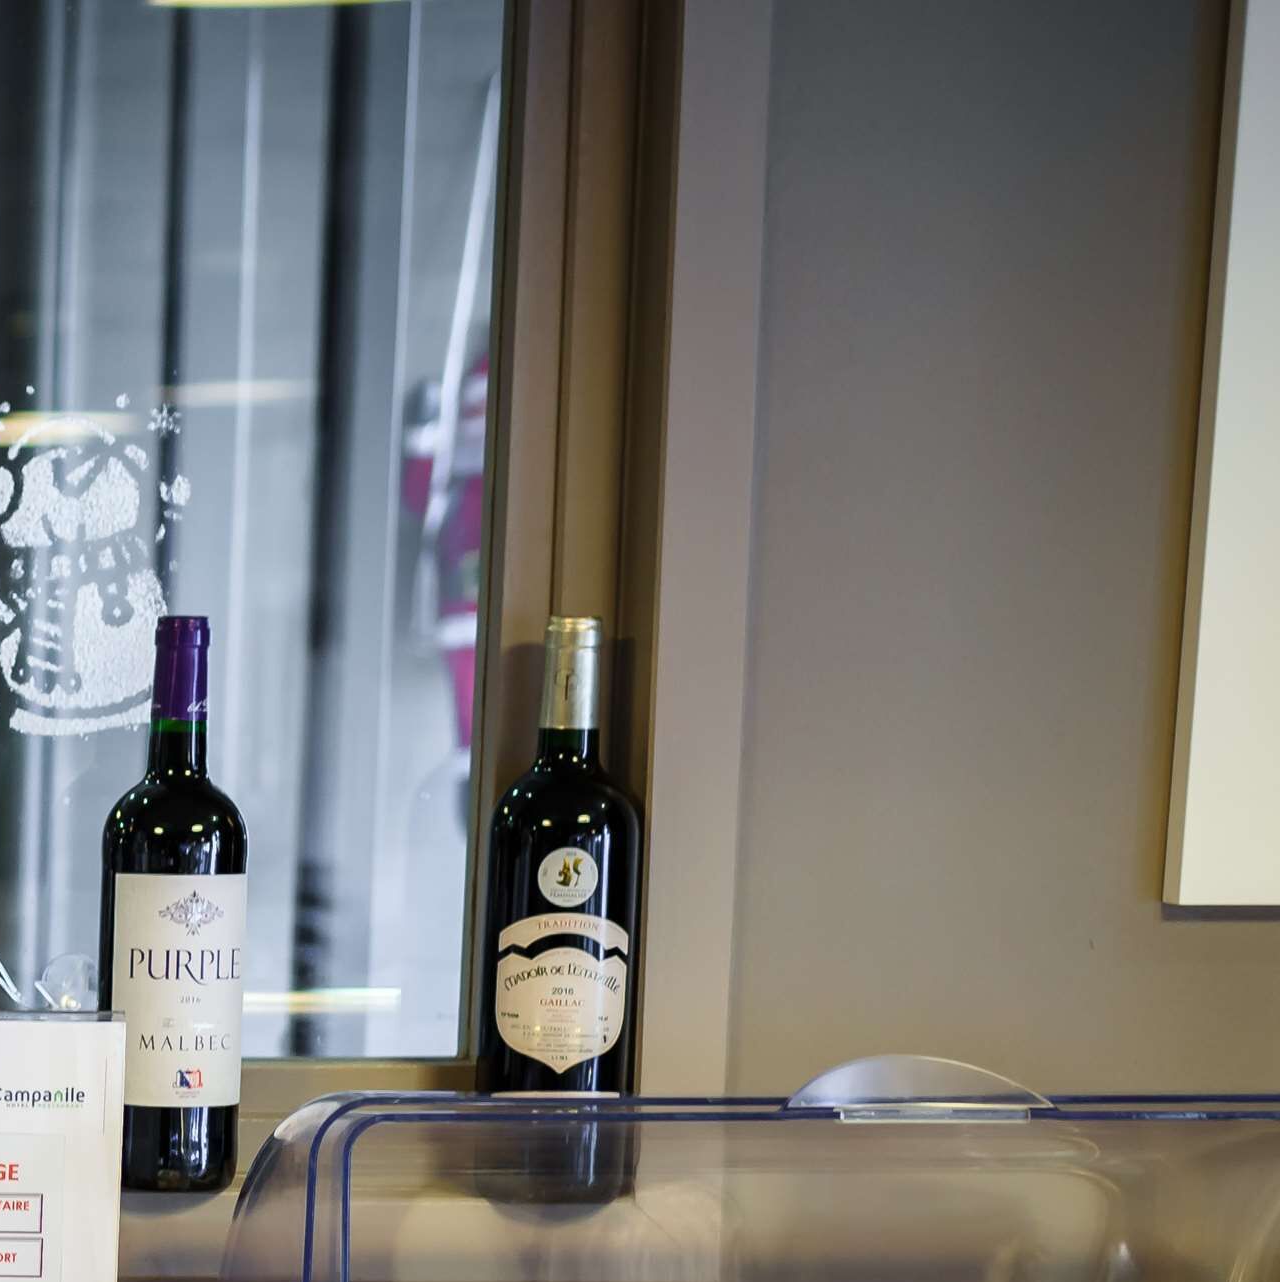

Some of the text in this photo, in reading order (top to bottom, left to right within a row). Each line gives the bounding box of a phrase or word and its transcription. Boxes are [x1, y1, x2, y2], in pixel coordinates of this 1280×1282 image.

[537, 919, 600, 931] TRADITION
[128, 947, 241, 986] PURPLE
[551, 987, 575, 996] 2016
[539, 998, 586, 1008] GAILLAC
[139, 1033, 232, 1051] MALBEC
